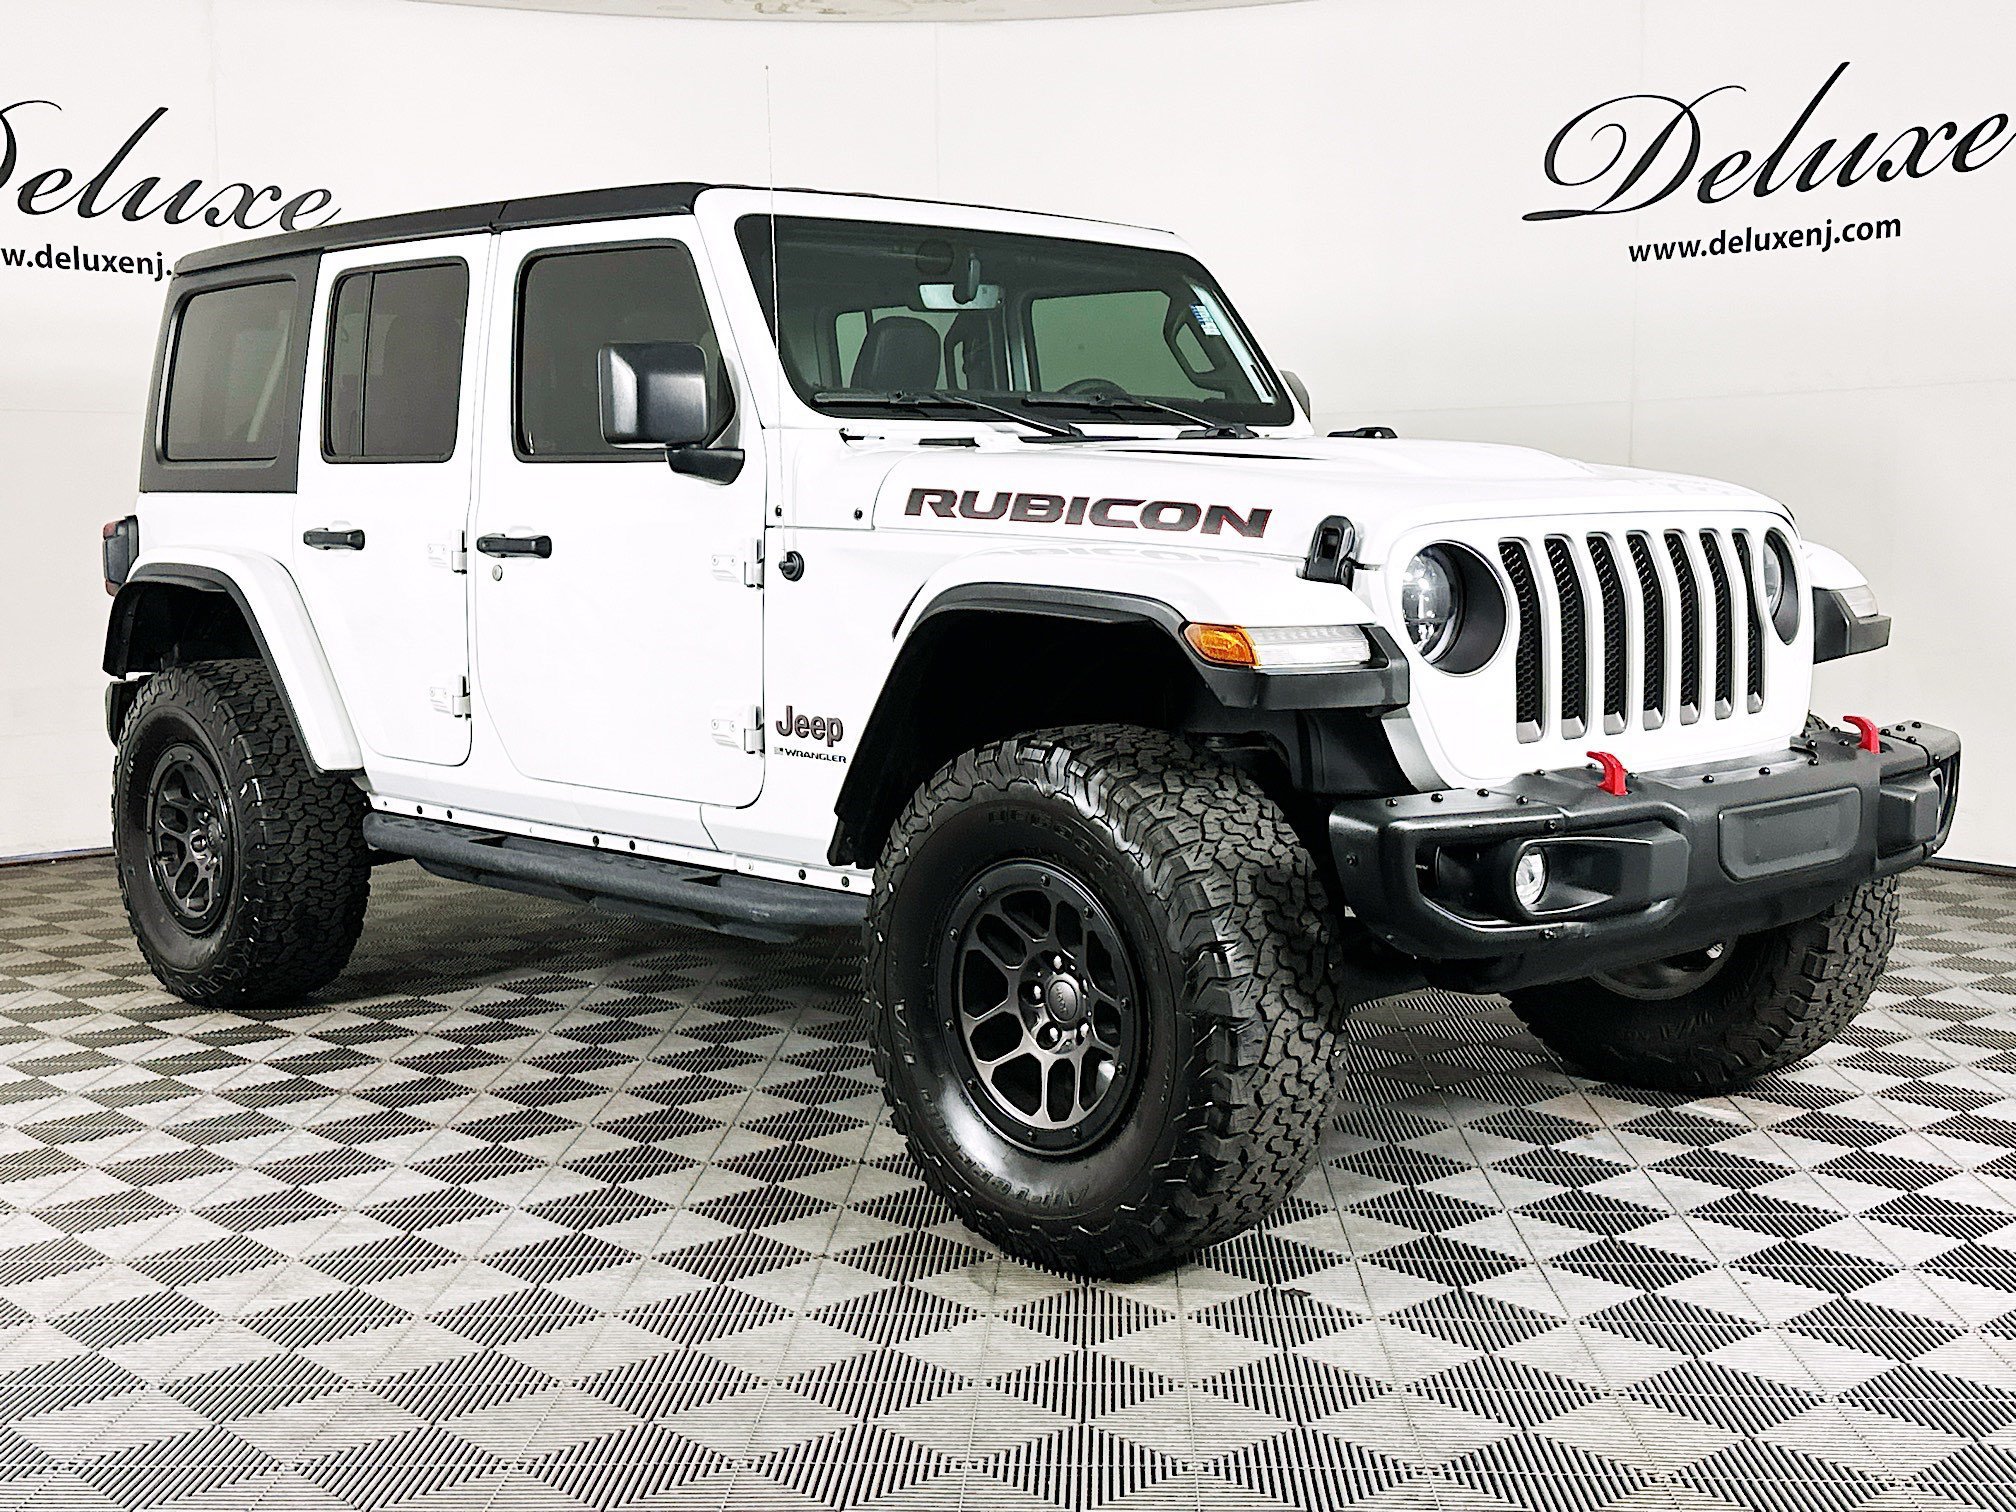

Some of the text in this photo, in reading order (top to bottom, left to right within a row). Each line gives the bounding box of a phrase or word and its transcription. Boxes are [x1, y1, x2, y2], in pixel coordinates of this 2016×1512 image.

[1521, 62, 2016, 221] Deluxe
[1628, 218, 1902, 263] www.deluxenj.com
[904, 487, 1273, 538] RUBICON
[776, 705, 844, 748] Jeep
[785, 748, 847, 764] WRANGLER
